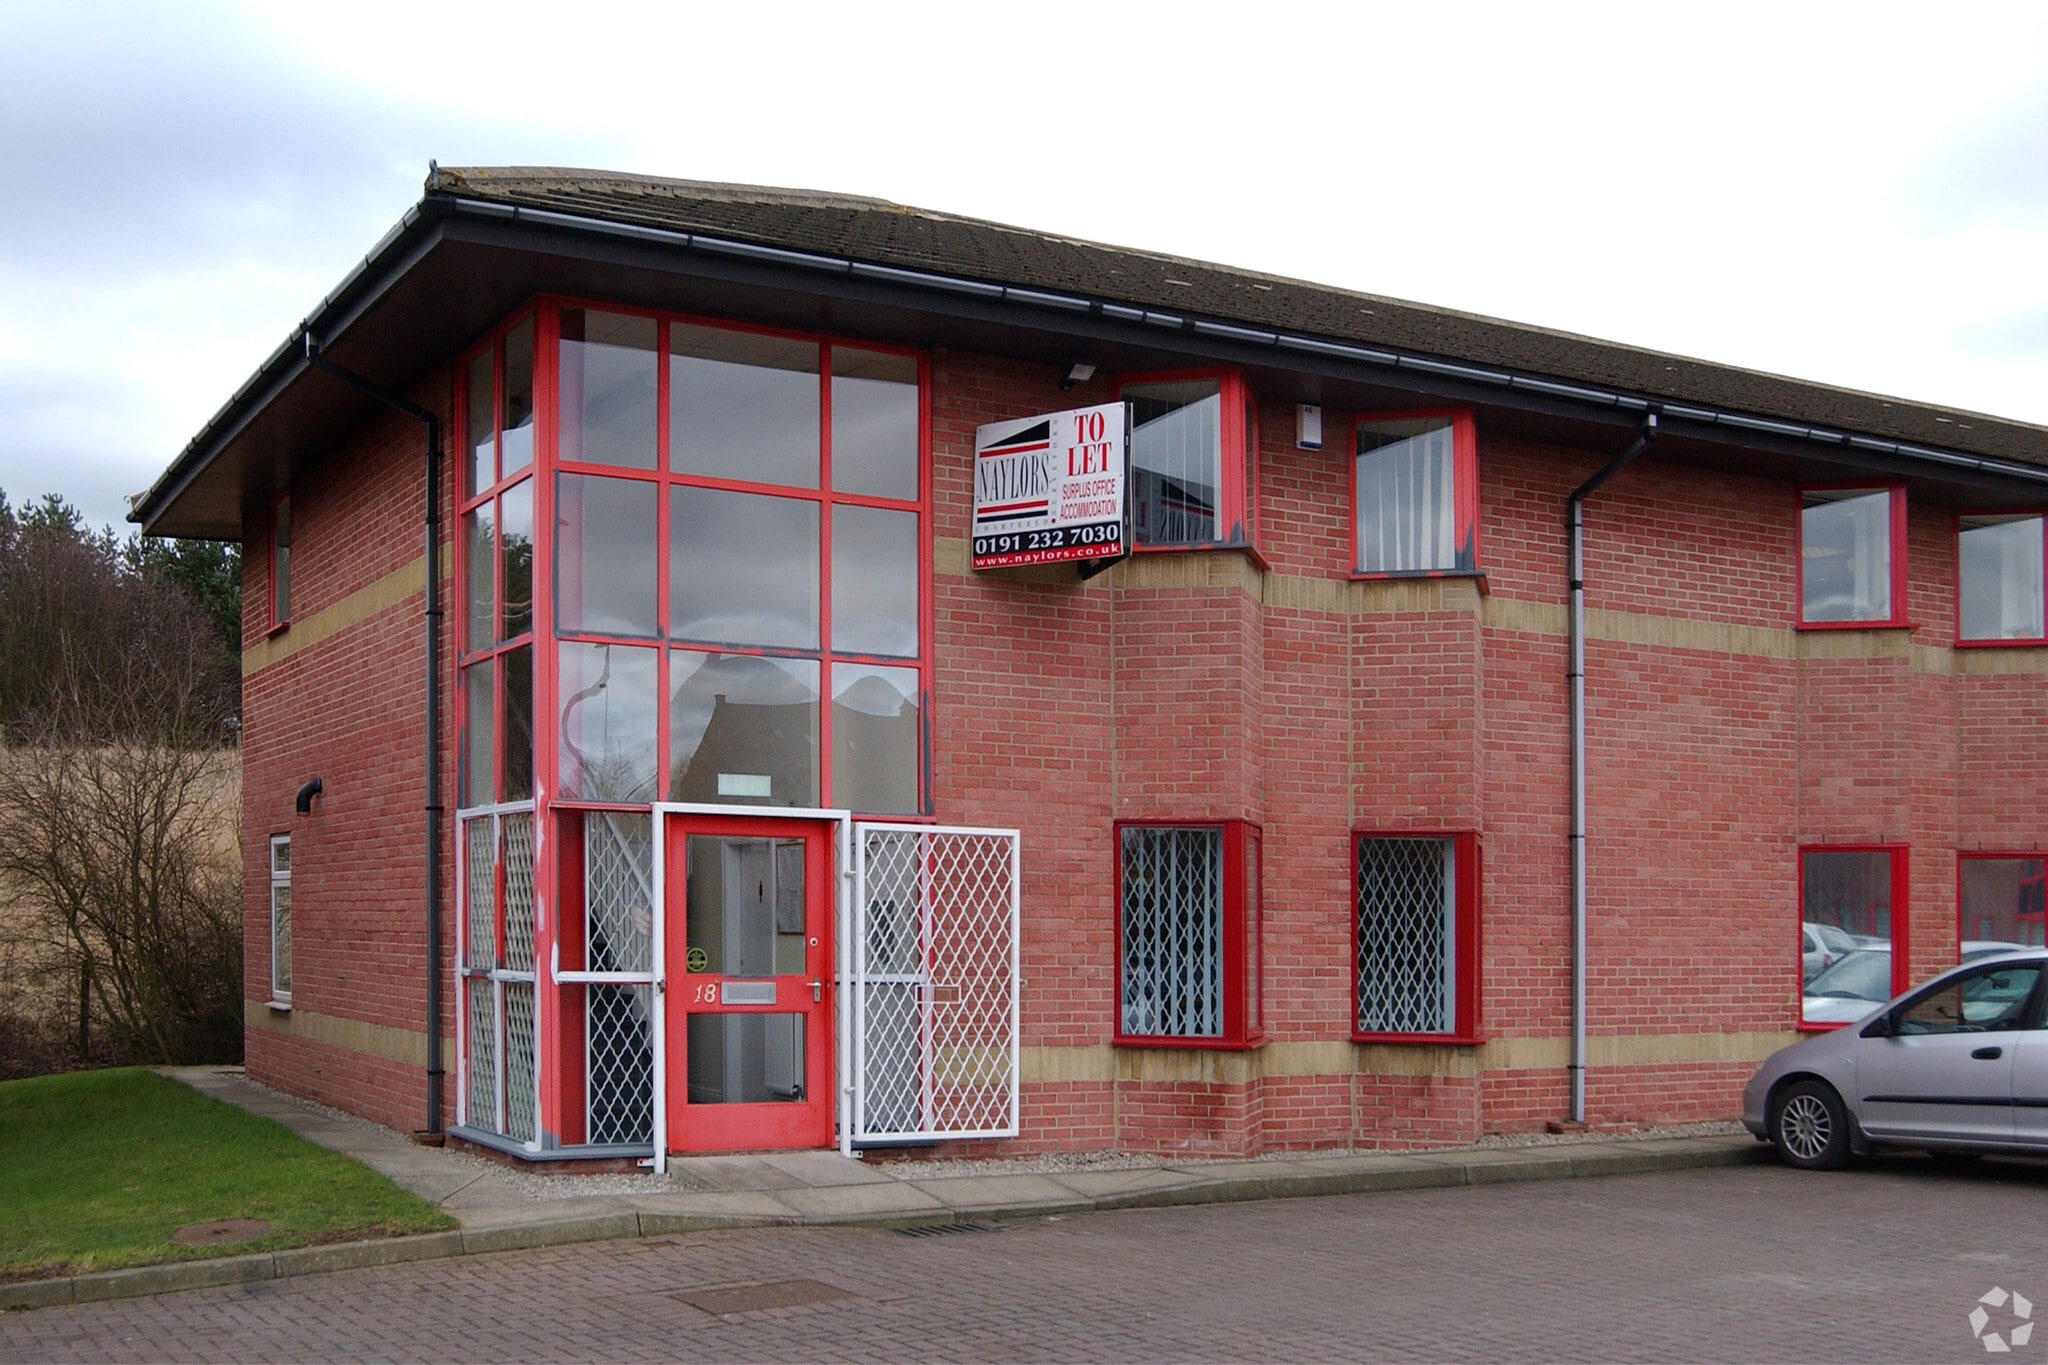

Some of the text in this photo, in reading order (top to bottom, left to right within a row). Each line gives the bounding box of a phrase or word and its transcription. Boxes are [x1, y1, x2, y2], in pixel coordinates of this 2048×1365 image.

[1073, 411, 1105, 444] TO
[1067, 441, 1112, 477] LET
[976, 452, 1049, 503] NAYLORS
[1062, 478, 1116, 500] SURPLUS OFFICE
[1060, 498, 1117, 520] ACCOMMODATION
[975, 524, 1119, 555] 0191 232 7030
[975, 543, 1119, 567] www.naylors.co.uk
[694, 983, 716, 1003] 18
